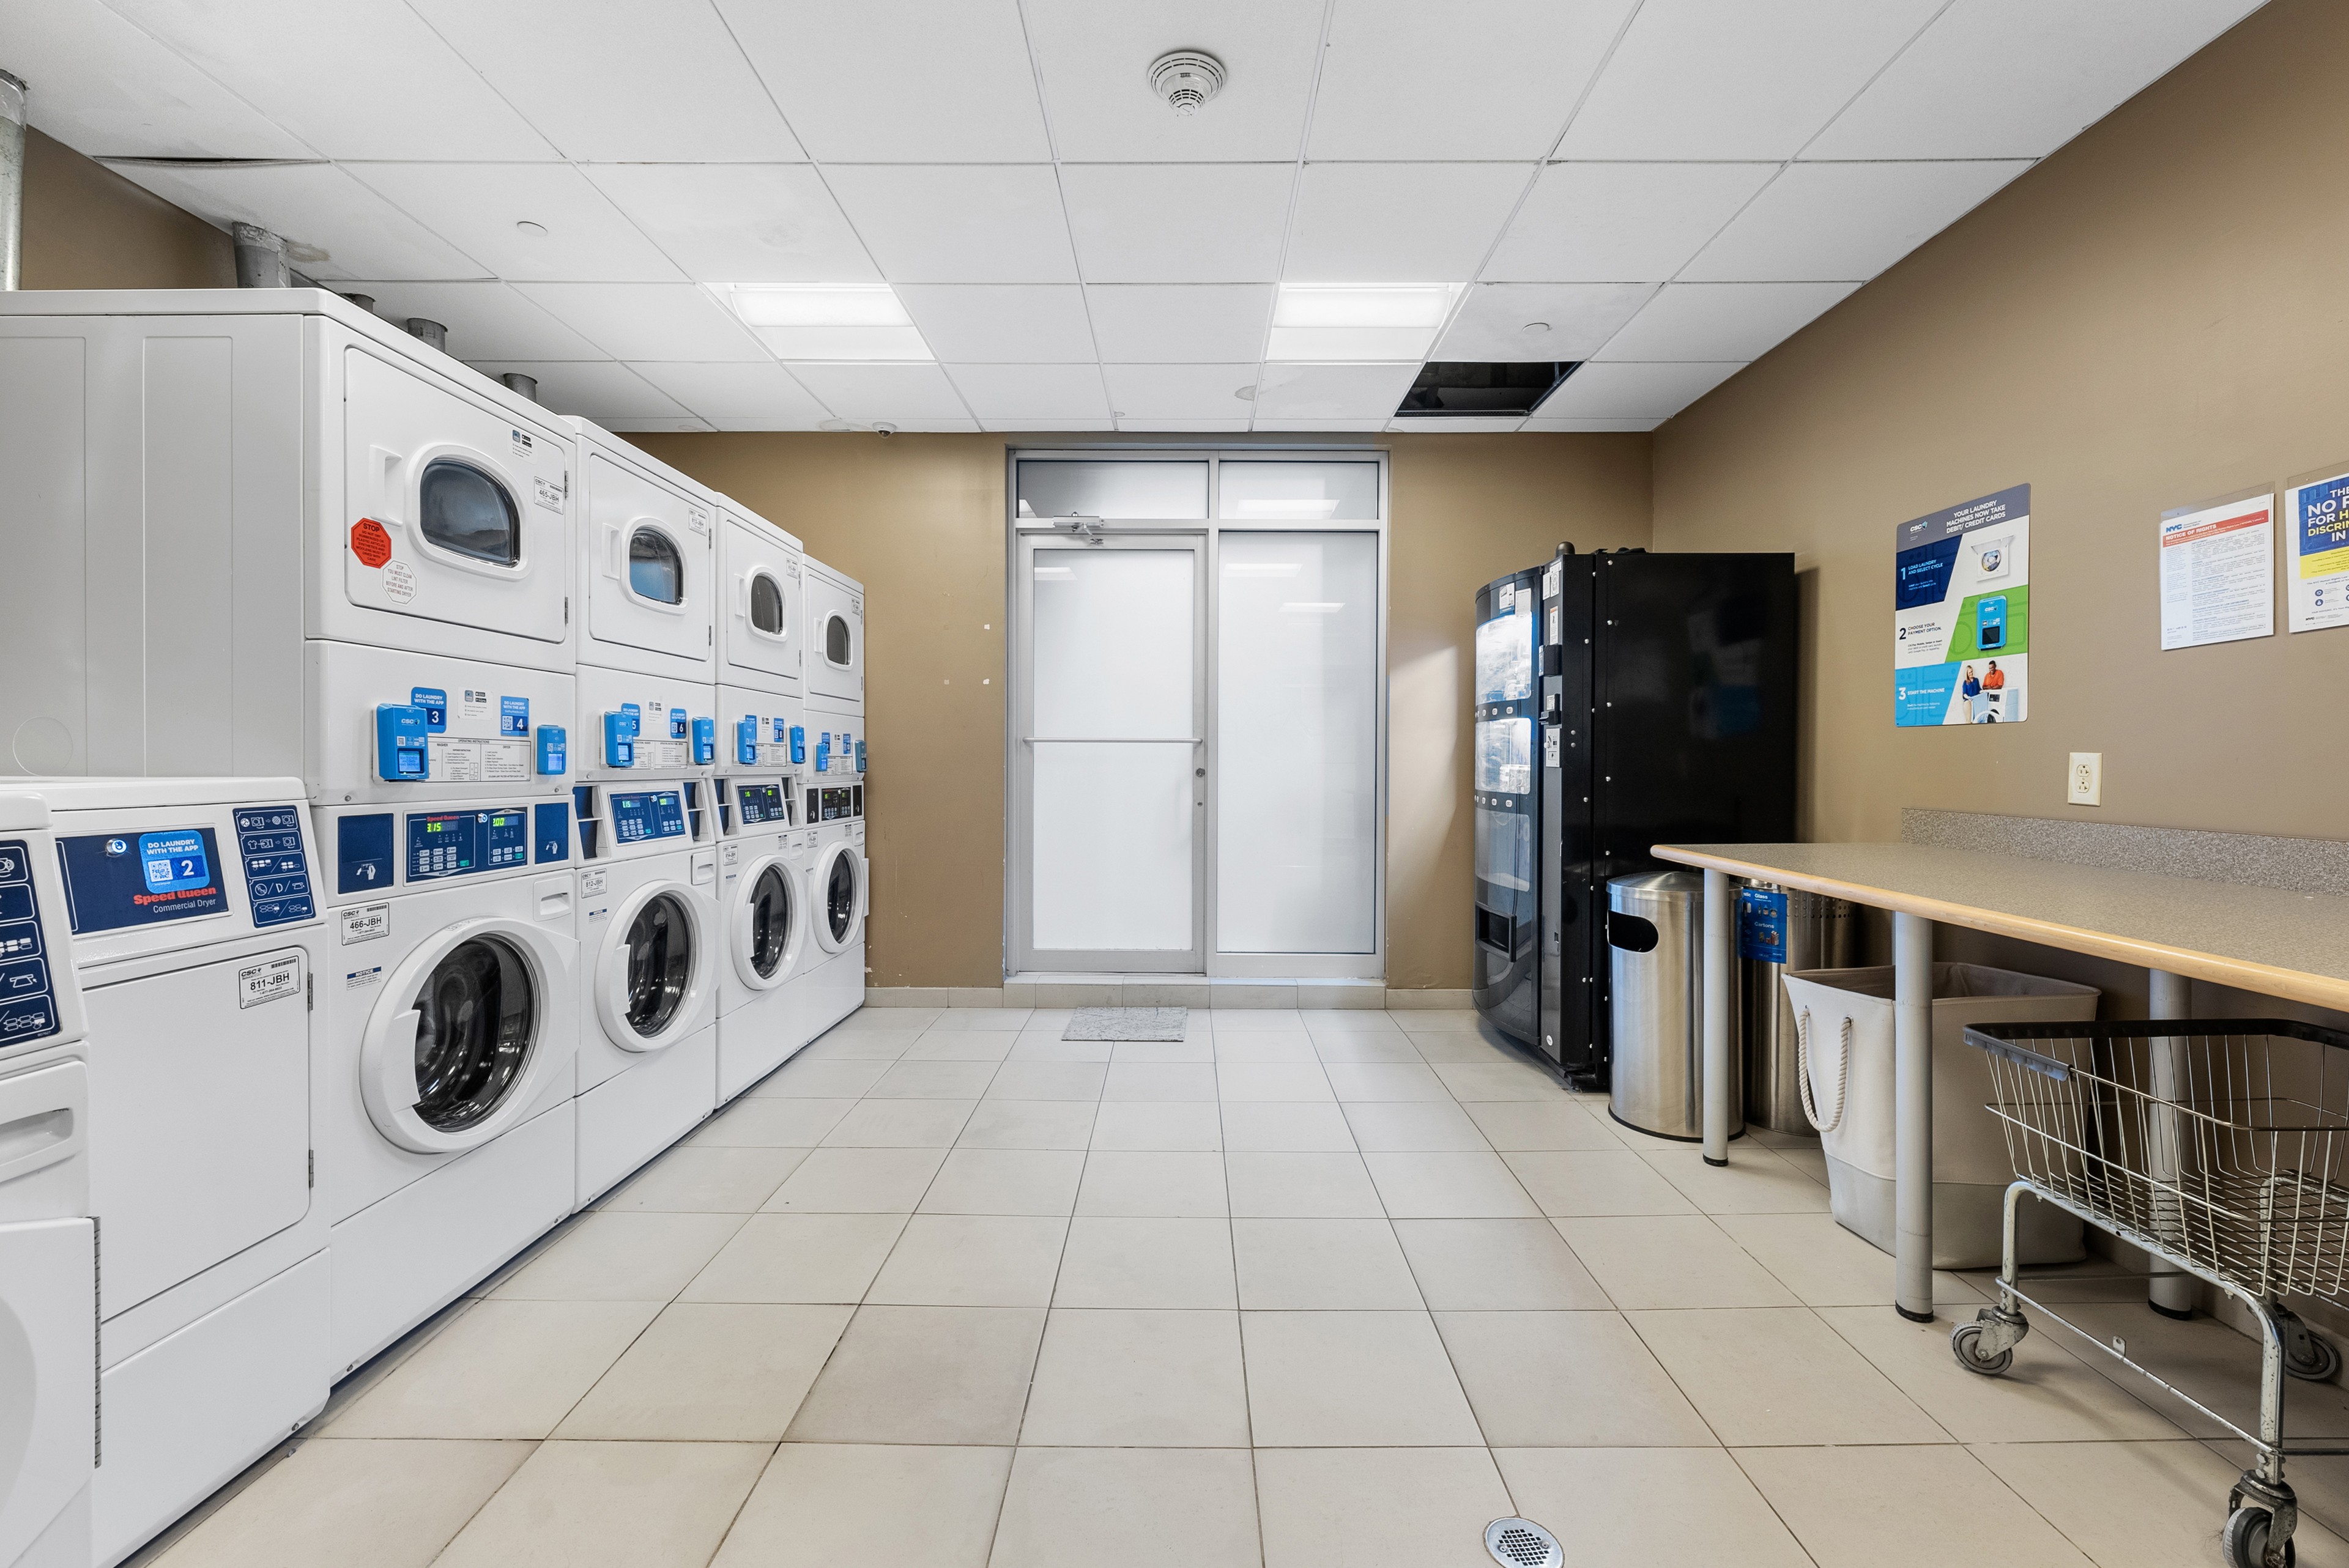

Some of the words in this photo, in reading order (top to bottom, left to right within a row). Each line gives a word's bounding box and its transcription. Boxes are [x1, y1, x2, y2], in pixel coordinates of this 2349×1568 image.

[539, 489, 559, 503] 465-JBH
[1954, 508, 1969, 518] YOUR
[1970, 500, 1997, 512] LAUNDRY
[2307, 500, 2336, 517] NO
[1946, 516, 1973, 527] MACHINES
[1975, 510, 1989, 520] NOW
[1991, 504, 2006, 514] TAKE
[2308, 513, 2336, 528] FOR
[363, 523, 380, 532] STOP
[1946, 524, 1963, 534] DEBIT/
[1965, 518, 1984, 528] CREDIT
[1986, 511, 2006, 522] CARDS
[2165, 523, 2183, 533] NYC
[2165, 532, 2186, 541] NOTICE
[2196, 524, 2217, 533] RIGHTS
[2331, 530, 2346, 542] IN
[1917, 565, 1930, 574] SELECT
[1931, 563, 1943, 571] CYCLE
[1918, 559, 1937, 568] LAUNDRY
[1901, 567, 1906, 580] 1
[387, 587, 401, 596] STARTING
[1899, 627, 1907, 640] 2
[1899, 687, 1906, 700] 3
[431, 711, 439, 723] 3
[516, 718, 524, 730] 4
[632, 720, 636, 730] 5
[679, 723, 683, 733] 6
[161, 839, 195, 848] LAUNDRY
[181, 860, 195, 876] 2
[585, 879, 603, 887] 812-JBH
[133, 892, 176, 905] Speed
[176, 887, 217, 899] Queen
[153, 900, 196, 913] Commercial
[197, 898, 216, 908] Dryer
[349, 917, 382, 930] 466-JBH
[241, 969, 257, 977] CSC
[355, 969, 373, 977] NOTICE
[250, 972, 289, 991] 811-JBH
